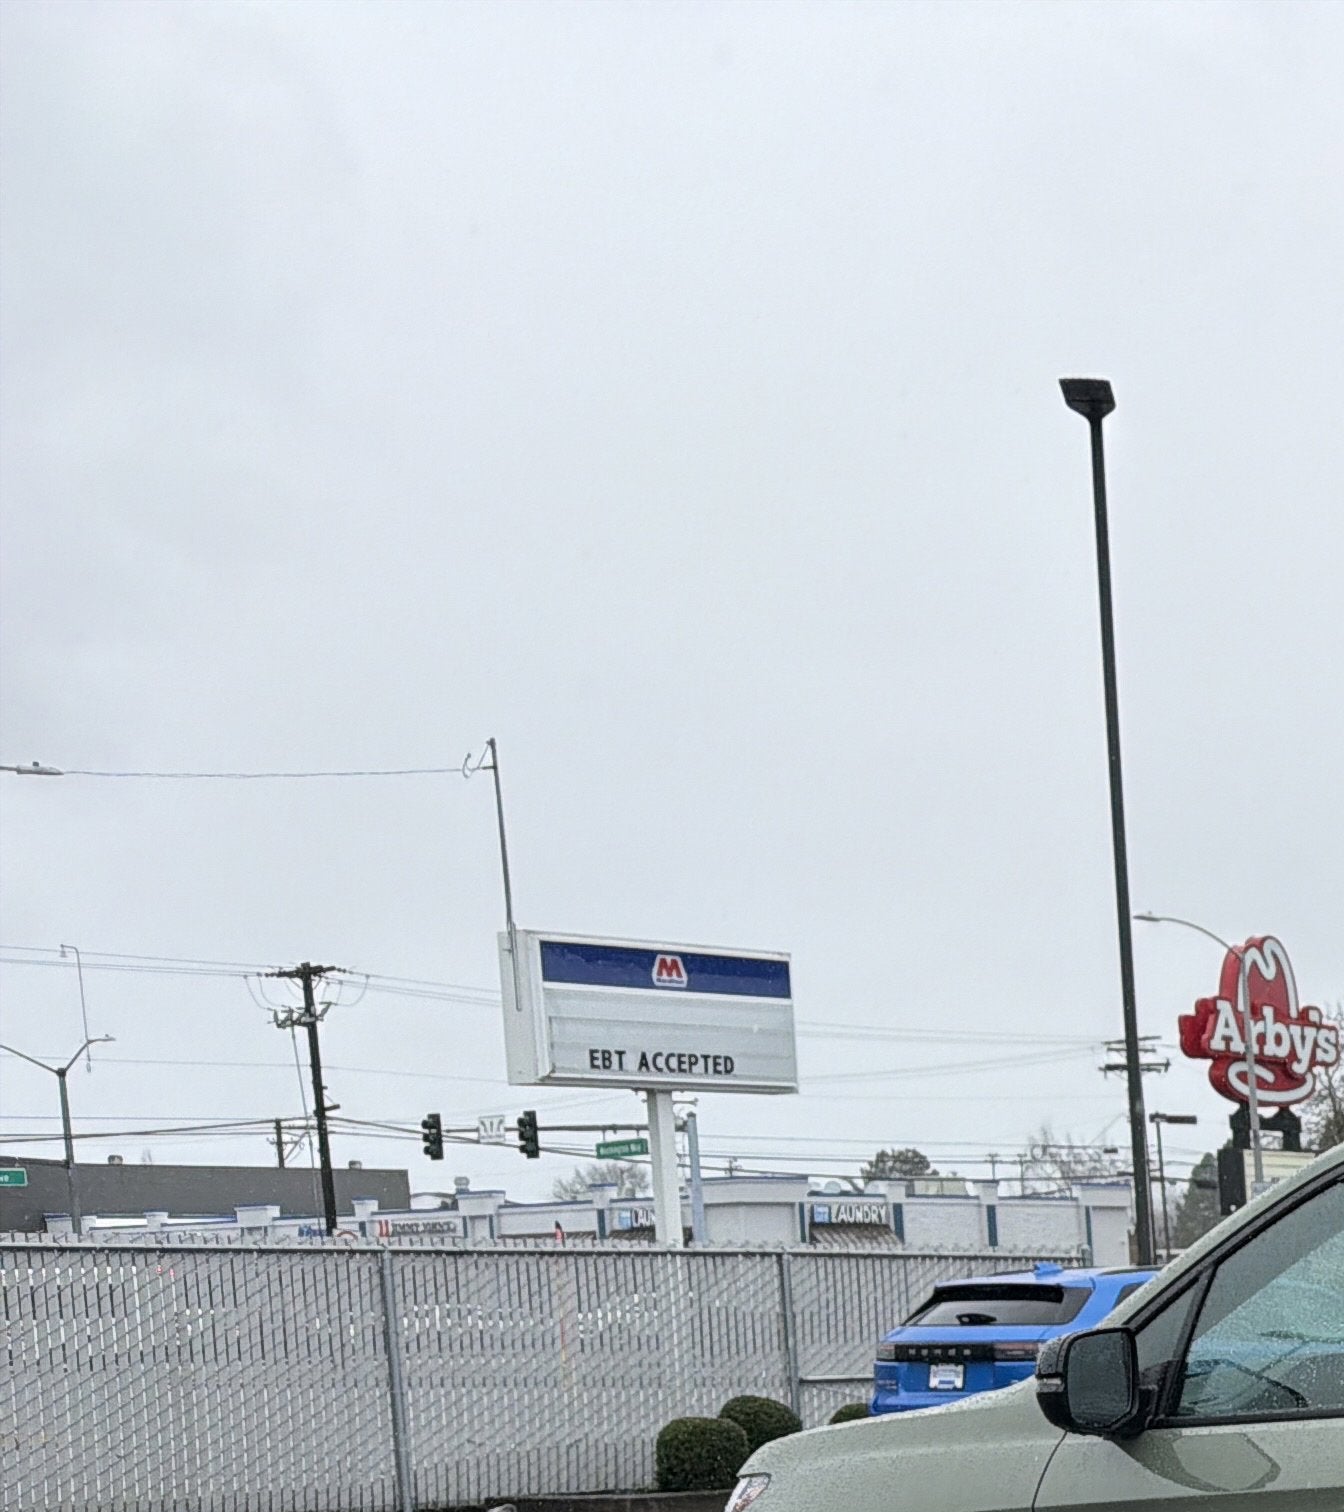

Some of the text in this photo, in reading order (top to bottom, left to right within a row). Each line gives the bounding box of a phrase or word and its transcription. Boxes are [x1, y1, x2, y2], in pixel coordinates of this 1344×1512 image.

[1209, 999, 1337, 1074] Arby's
[589, 1049, 735, 1075] EBT ACCEPTED
[631, 1207, 656, 1229] LAUN
[831, 1203, 888, 1224] LAUNDRY
